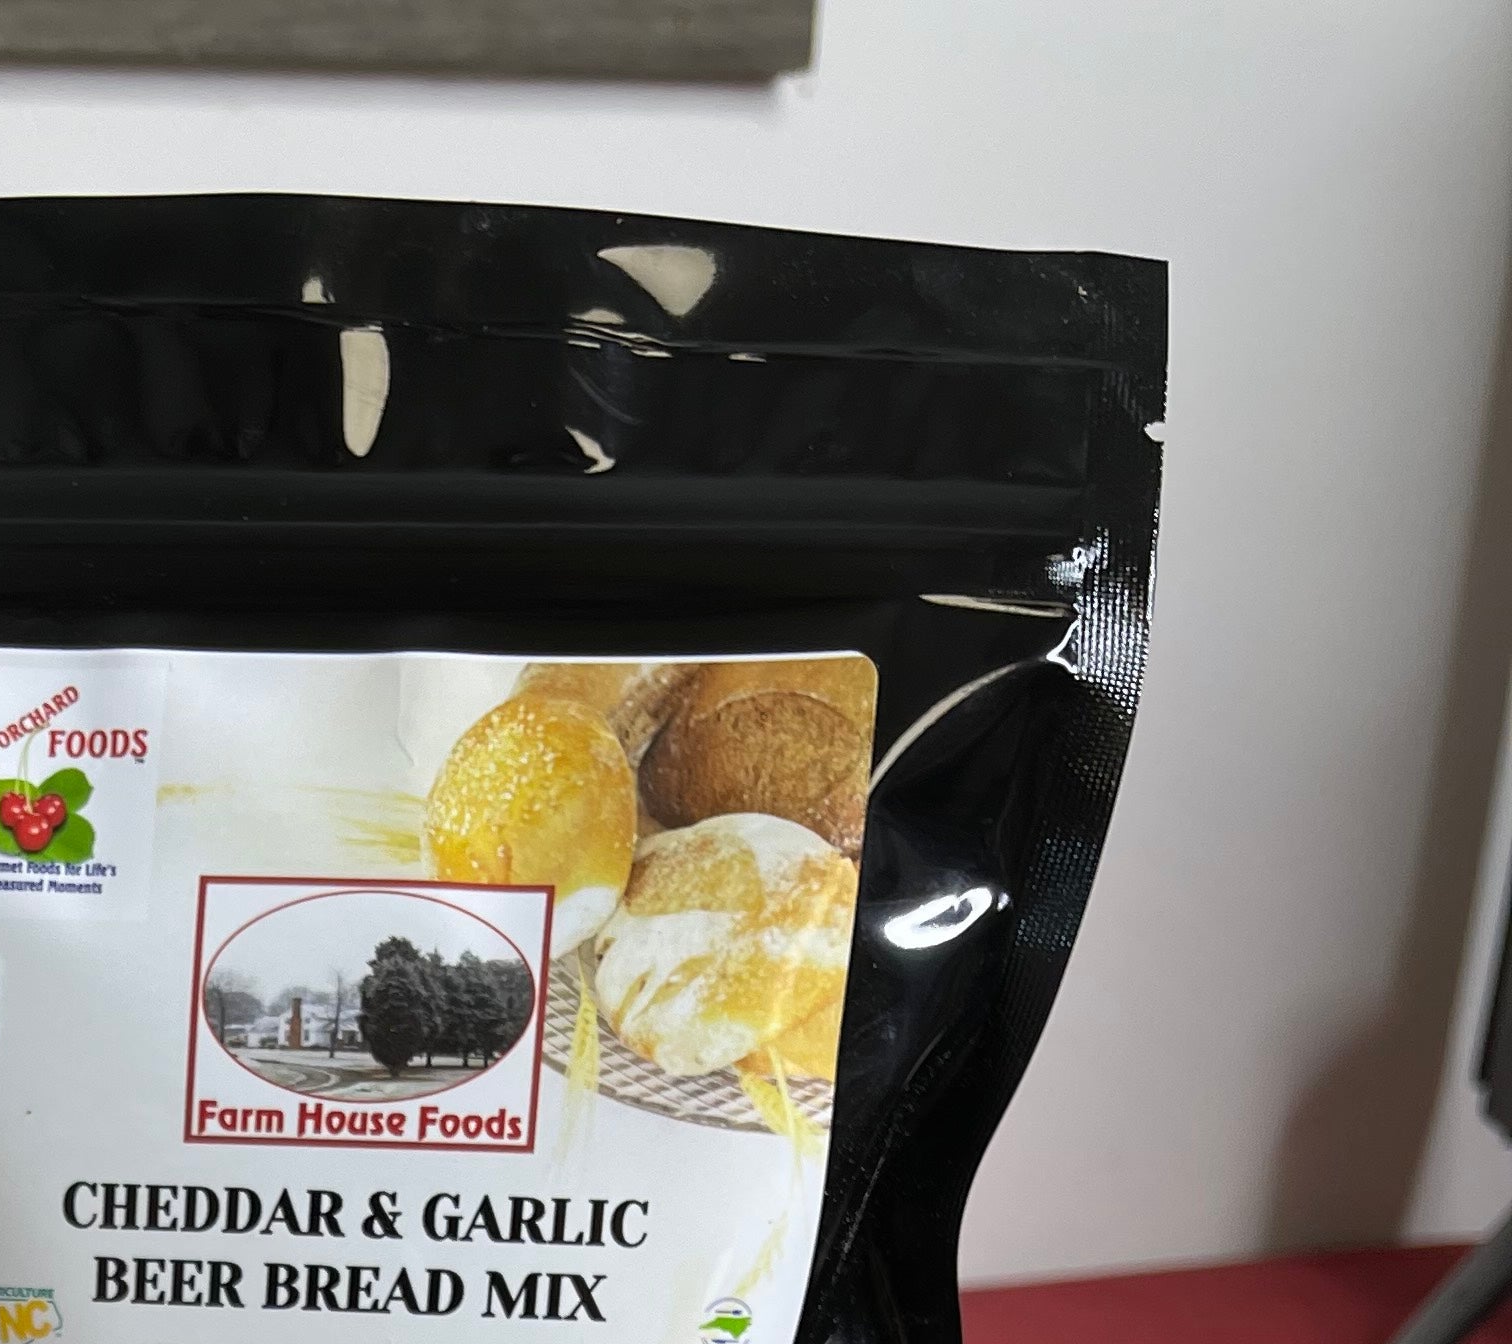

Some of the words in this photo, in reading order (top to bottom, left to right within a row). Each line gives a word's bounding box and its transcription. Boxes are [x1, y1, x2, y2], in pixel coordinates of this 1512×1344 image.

[48, 729, 148, 758] FOODS
[27, 861, 60, 875] Foods
[48, 881, 102, 894] Moments
[197, 1100, 284, 1135] Farm
[297, 1103, 406, 1138] House
[418, 1106, 522, 1141] Foods
[62, 1181, 345, 1237] CHEDDAR
[360, 1191, 404, 1239] &
[422, 1192, 649, 1248] GARLIC
[92, 1256, 244, 1309] BEER
[262, 1262, 465, 1316] BREAD
[480, 1270, 607, 1322] MIX
